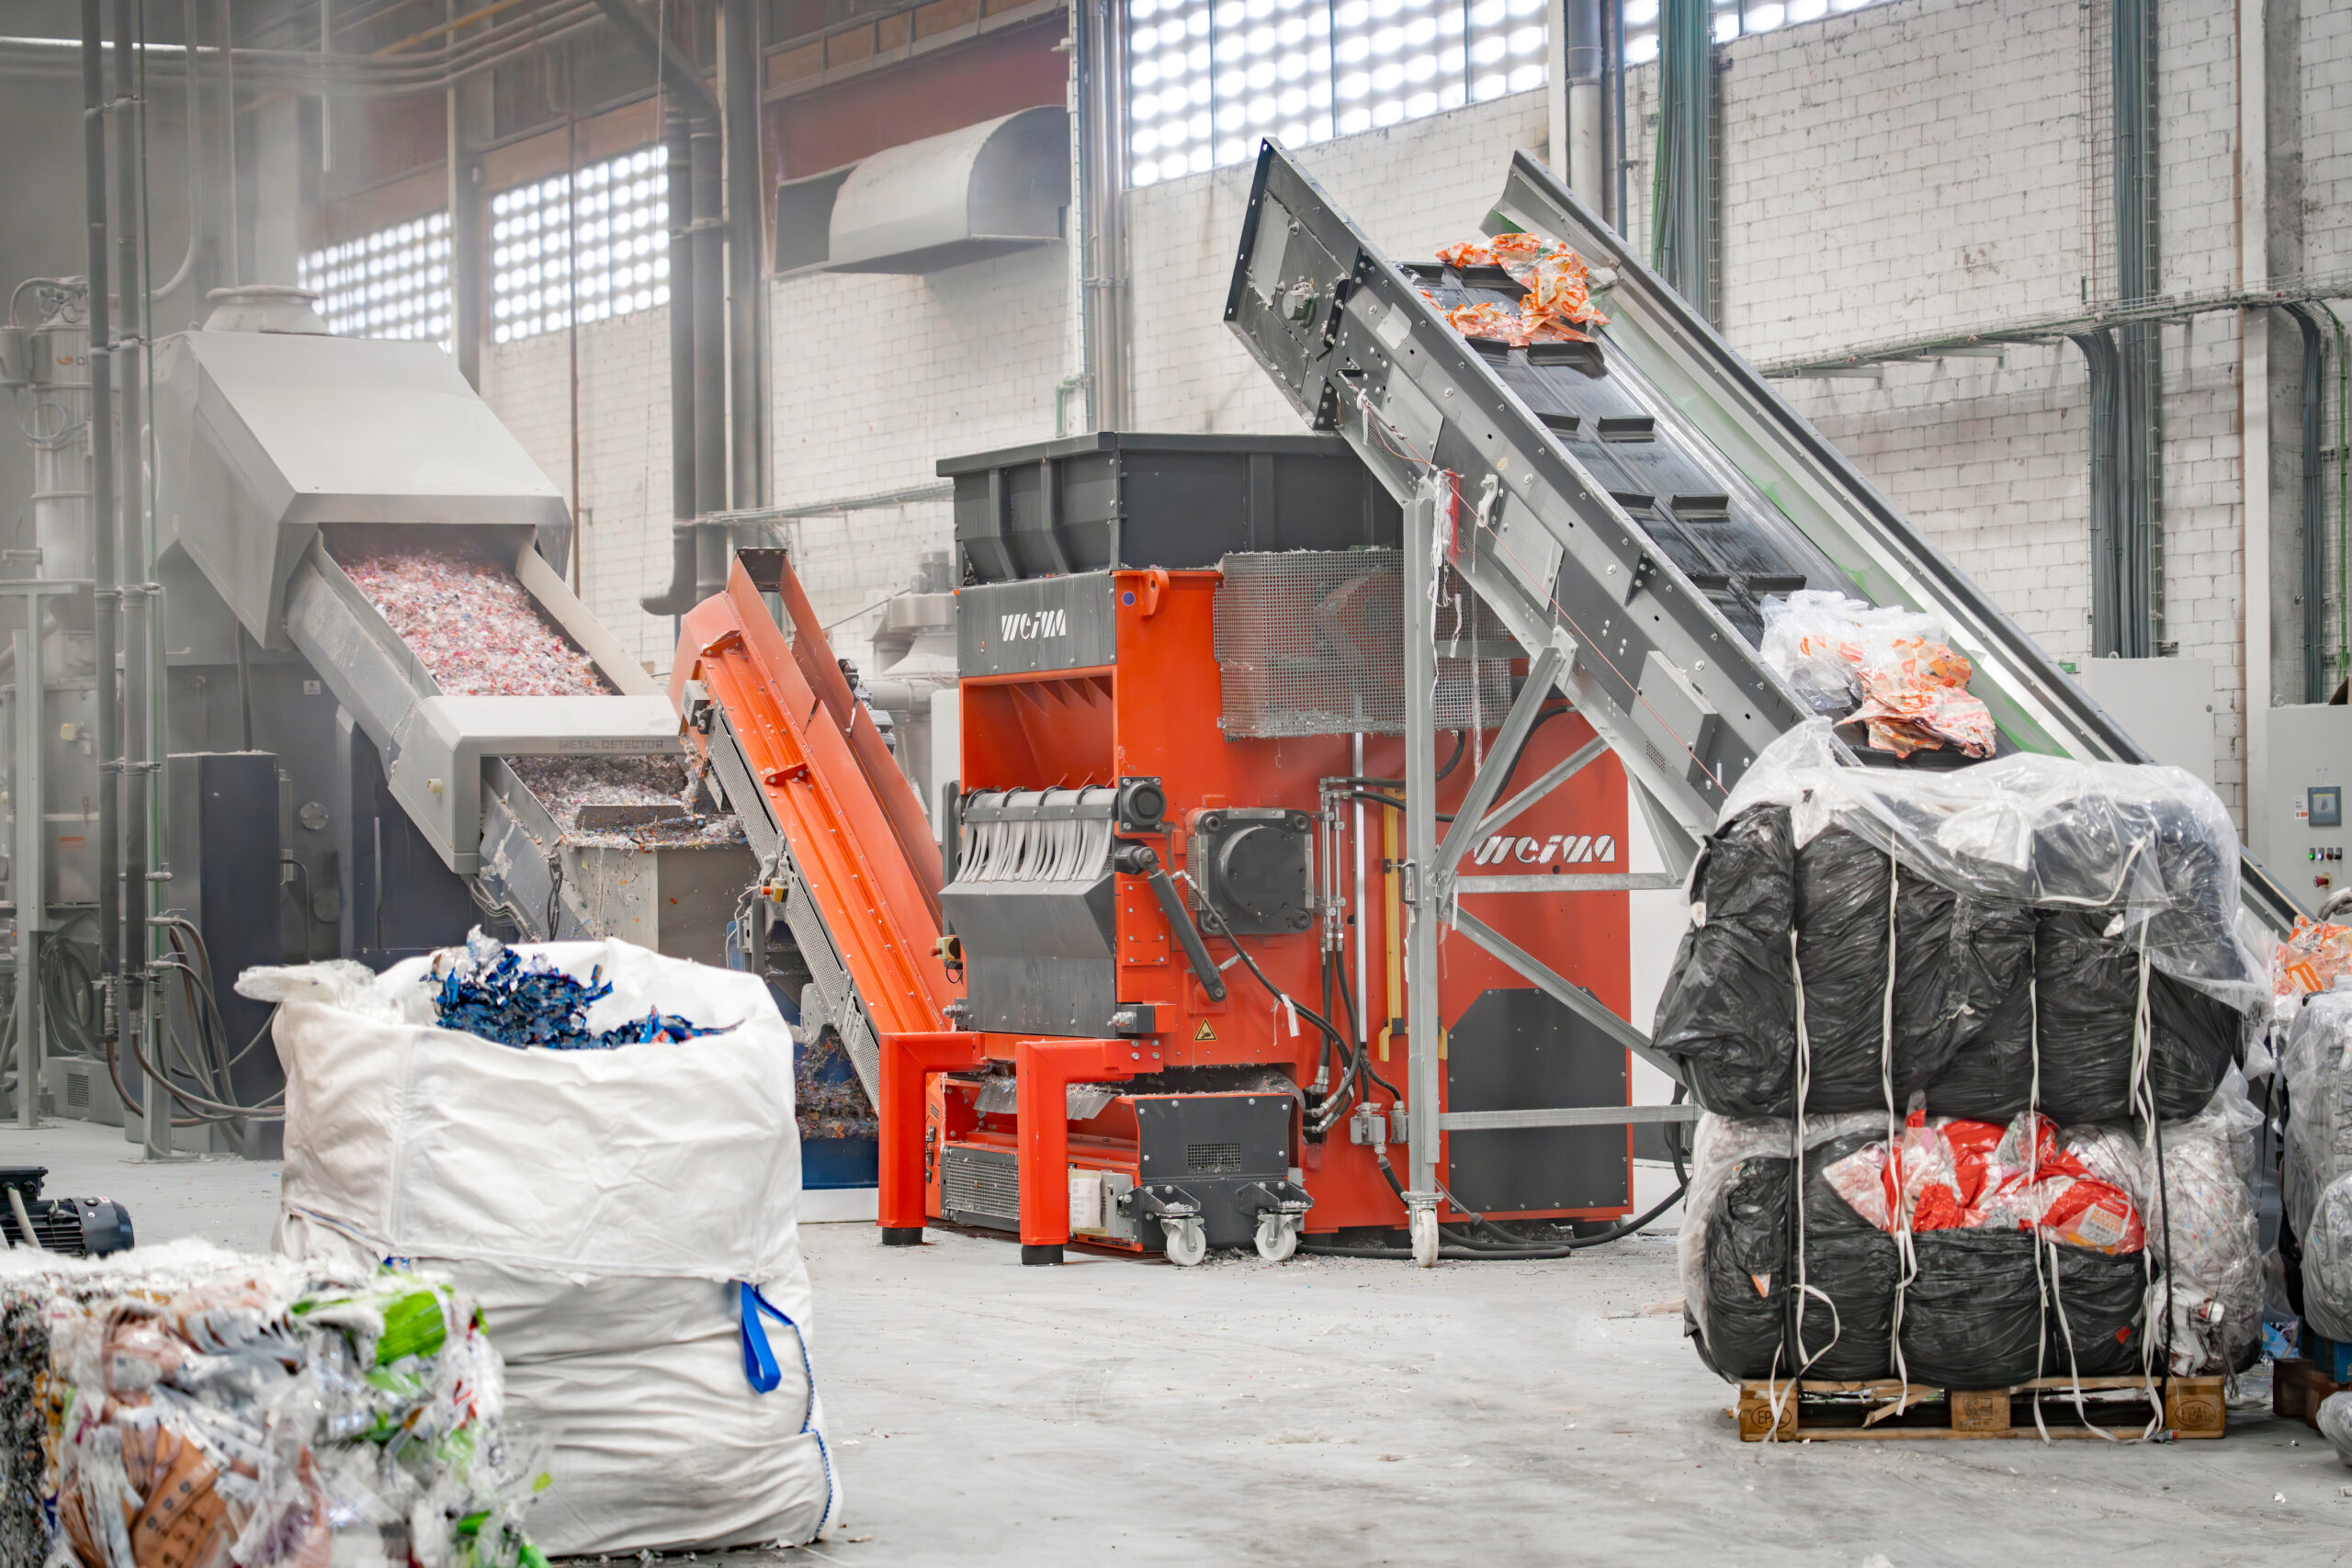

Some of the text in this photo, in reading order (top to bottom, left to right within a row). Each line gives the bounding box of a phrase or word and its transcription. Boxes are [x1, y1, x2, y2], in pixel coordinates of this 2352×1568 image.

[558, 739, 663, 749] METAL DETECTOR
[1758, 1410, 1787, 1425] EPL
